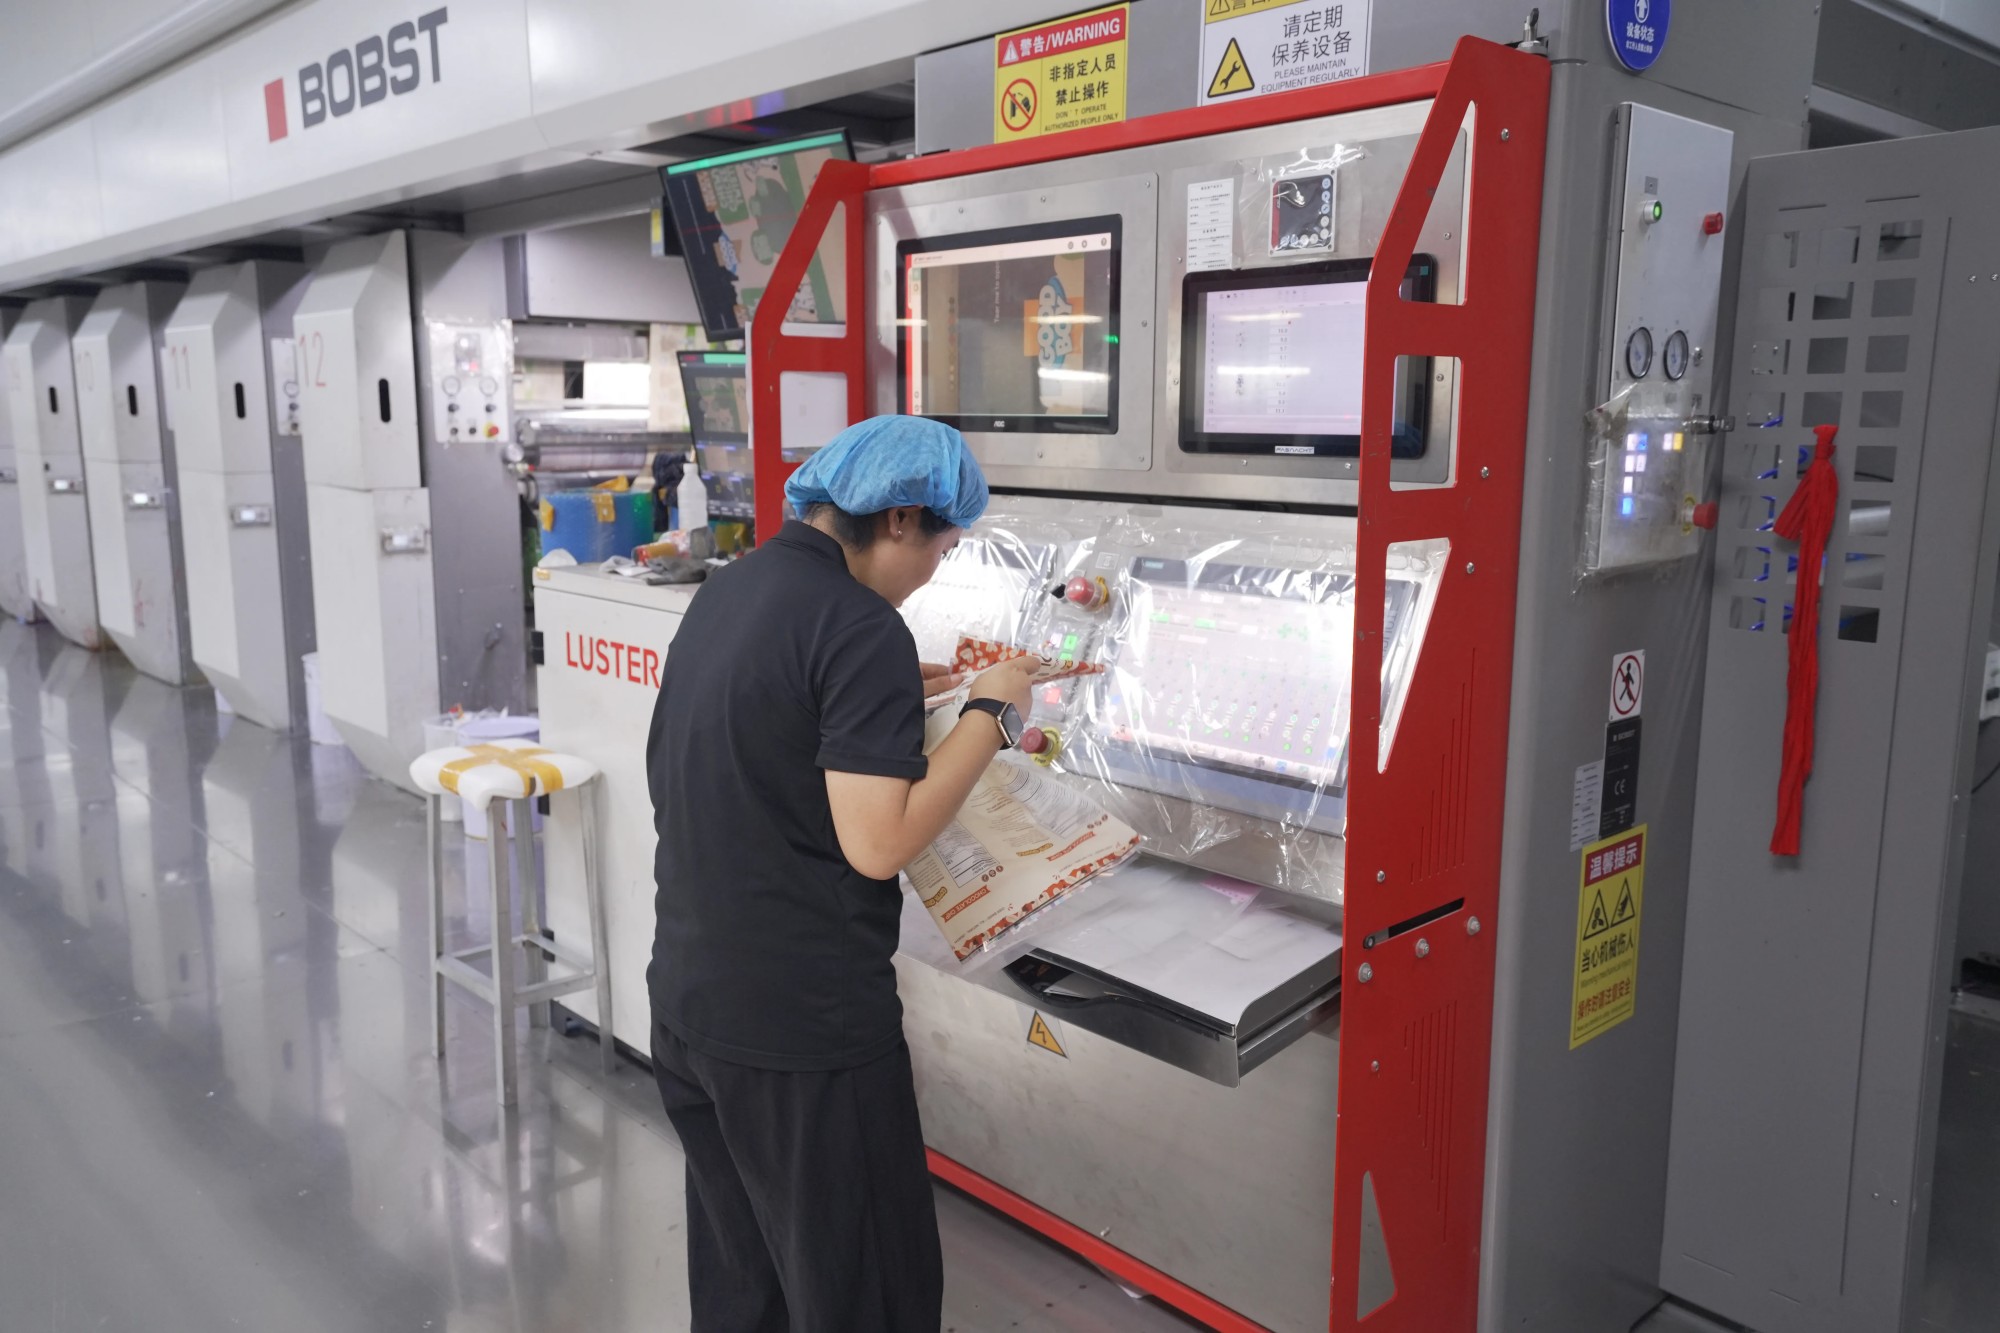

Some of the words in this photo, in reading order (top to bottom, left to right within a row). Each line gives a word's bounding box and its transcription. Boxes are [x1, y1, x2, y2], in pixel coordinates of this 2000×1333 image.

[1283, 4, 1343, 38] 请定期
[1626, 21, 1655, 42] 设备状态
[1272, 31, 1352, 68] 保养设备
[299, 6, 448, 129] BOBST
[1049, 53, 1116, 82] 非指定人员
[1261, 78, 1310, 93] EQUIPMENT
[1309, 67, 1361, 84] REGULARLY
[1274, 66, 1305, 80] PLEASE
[1307, 58, 1347, 74] MAINTAIN
[1055, 80, 1110, 106] 禁止操作
[1044, 119, 1080, 132] AUTHORIZED
[1080, 116, 1101, 127] PEOPLE
[1102, 112, 1120, 123] ONLY
[1080, 103, 1107, 115] OPERATE
[300, 331, 327, 387] 12
[566, 631, 660, 689] LUSTER
[1590, 842, 1638, 880] 温馨提示
[956, 888, 987, 910] CHOCOLATE
[945, 909, 956, 920] CHIP
[1581, 928, 1634, 973] 当心机械伤人
